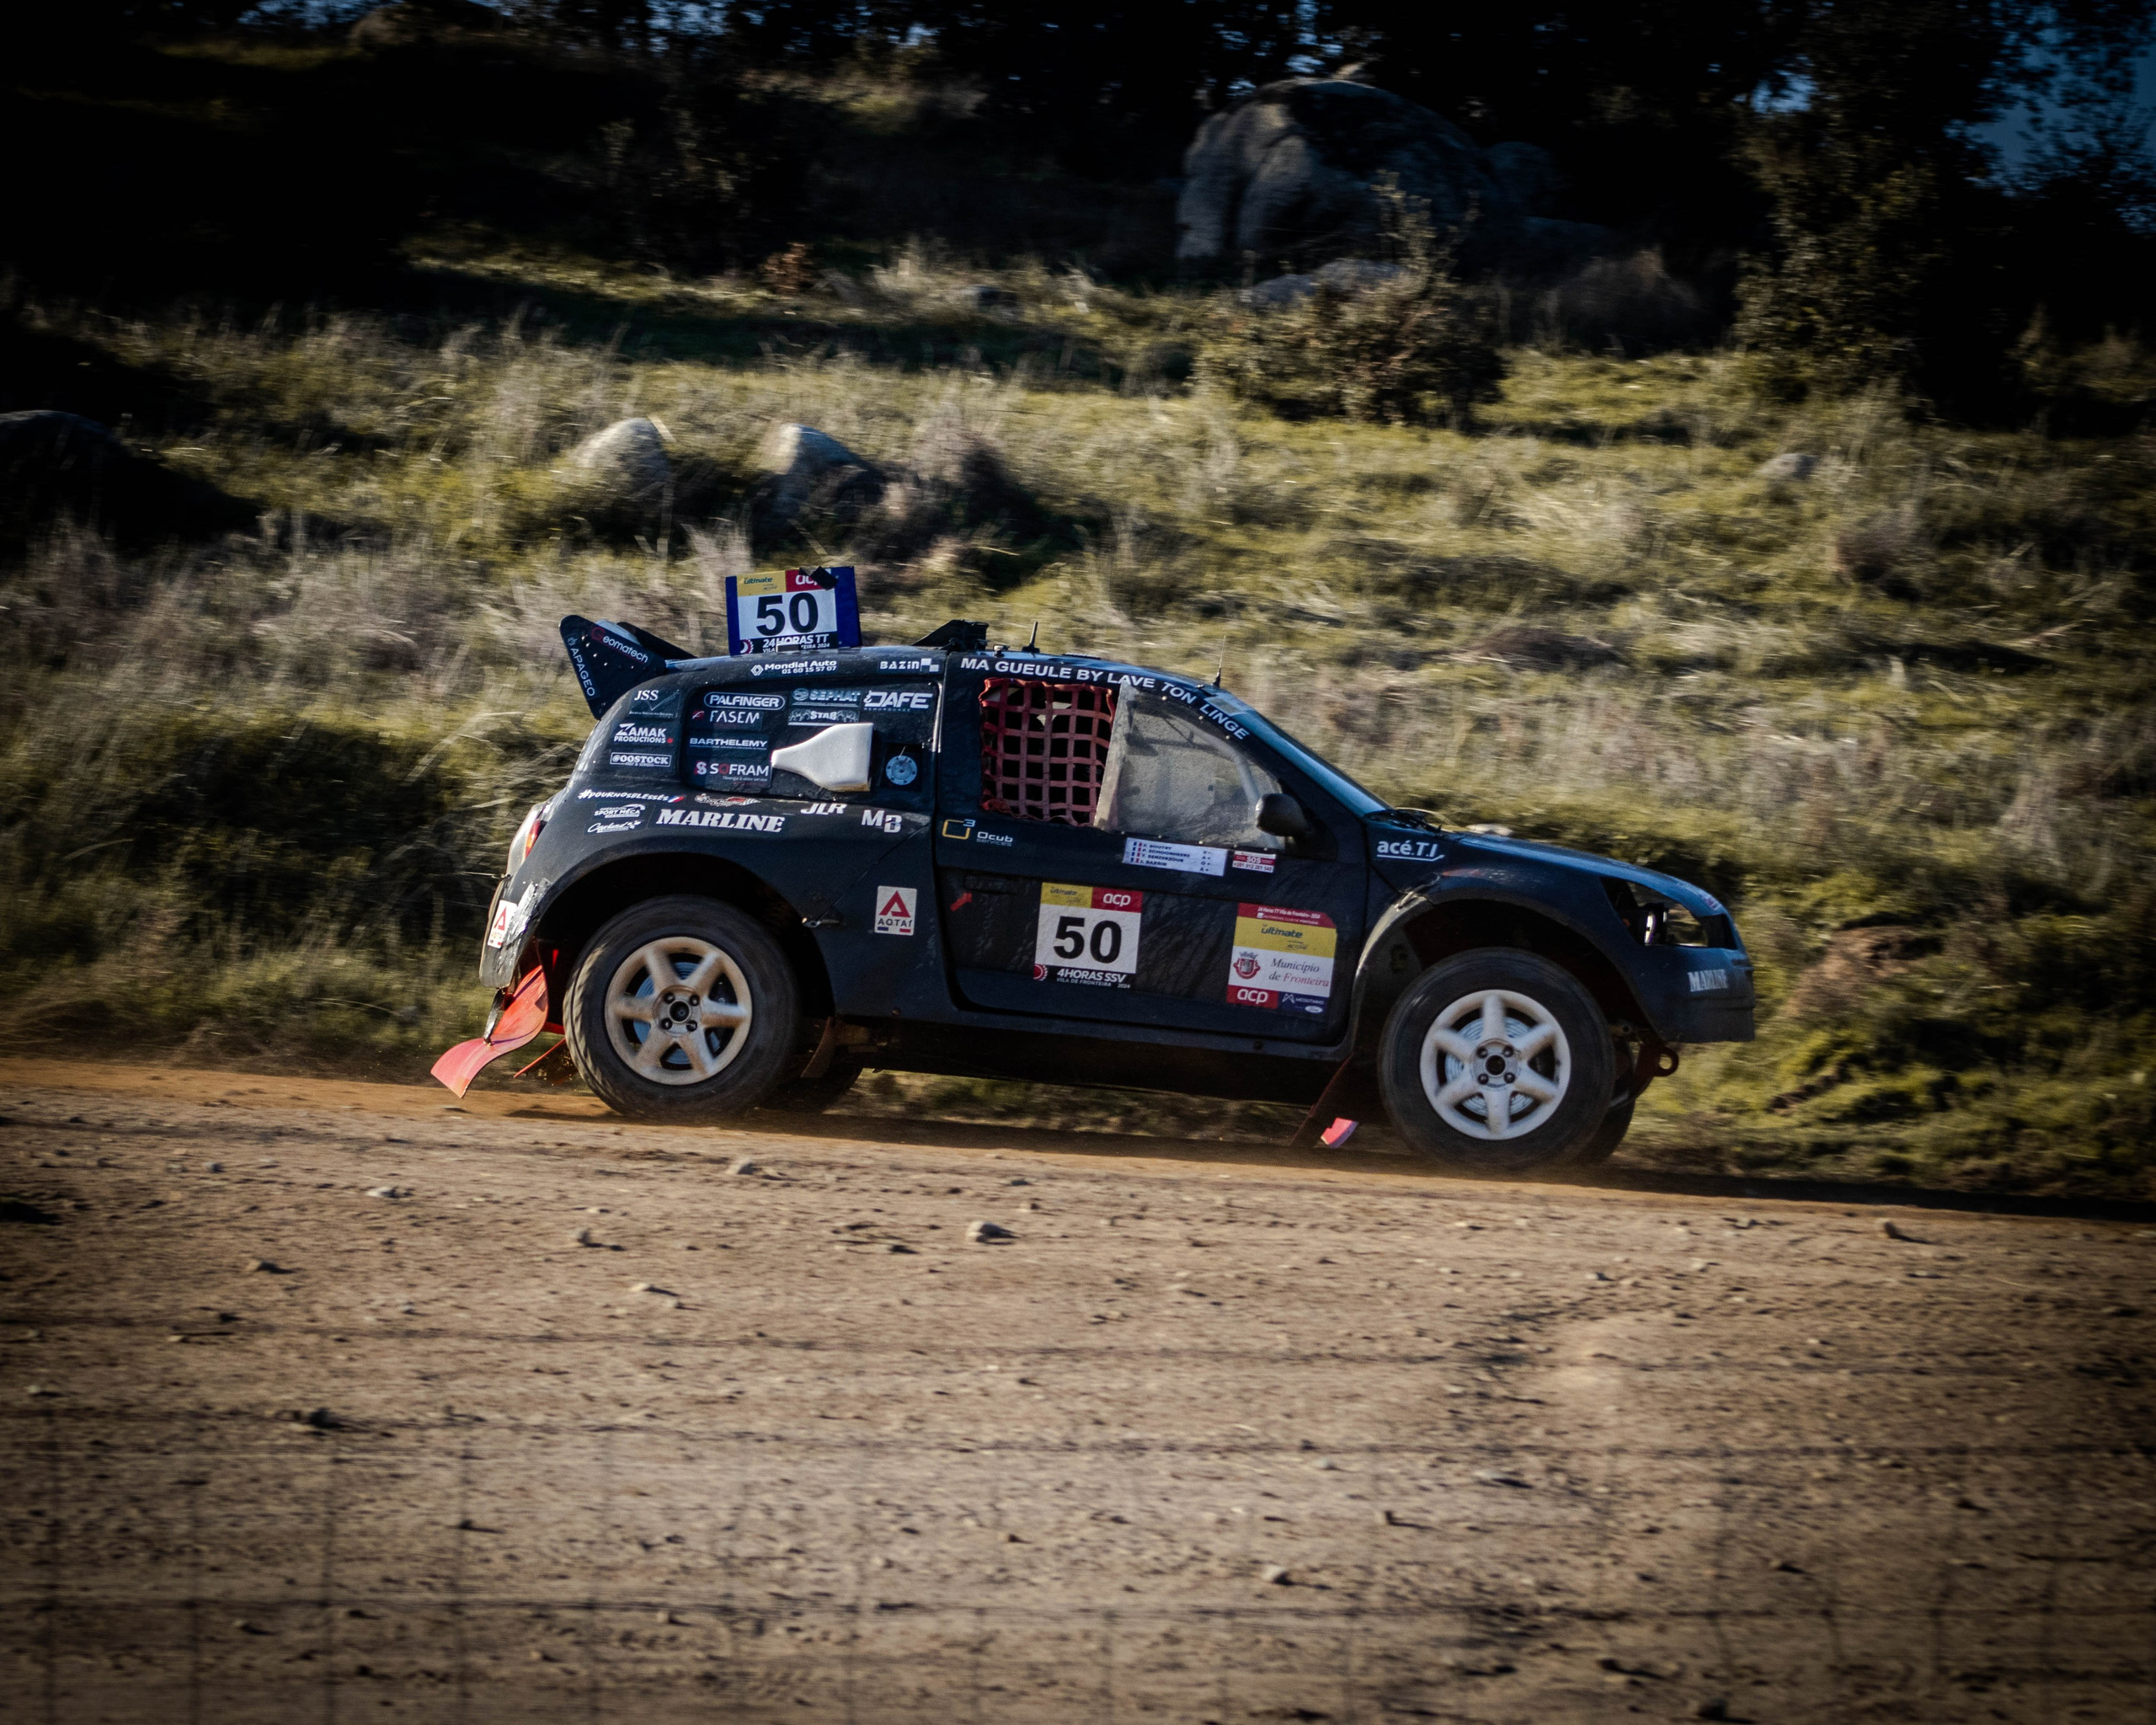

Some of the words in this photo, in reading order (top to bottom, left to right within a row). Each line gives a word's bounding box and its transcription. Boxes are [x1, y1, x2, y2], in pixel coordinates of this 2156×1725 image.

[795, 574, 817, 585] ac
[756, 592, 819, 637] 50
[591, 627, 648, 663] Geomatech
[815, 633, 829, 644] TT
[765, 661, 808, 670] Mondial
[570, 648, 595, 697] APAGEO
[634, 690, 659, 701] JSS
[710, 695, 779, 708] PALFINGER
[960, 658, 990, 670] MA
[995, 660, 1072, 679] GUEULE
[1076, 670, 1103, 681] BY
[1107, 673, 1155, 688] LAVE
[1161, 681, 1197, 704] TON
[1200, 703, 1249, 740] LINGE
[710, 711, 760, 724] FASEM
[616, 723, 667, 737] ZAMAK
[690, 738, 767, 747] BARTHELEMY
[710, 763, 769, 776] SOFRAM
[800, 803, 847, 815] JLR
[656, 809, 785, 833] MARLINE
[977, 831, 1013, 842] Ocub
[977, 838, 1012, 846] services
[1103, 894, 1130, 906] acp
[1261, 927, 1303, 937] ultimate
[1054, 916, 1121, 964] 50
[1104, 973, 1126, 983] SSV
[1268, 971, 1281, 980] de
[1283, 973, 1329, 987] Fronteira
[1237, 989, 1268, 1004] acp
